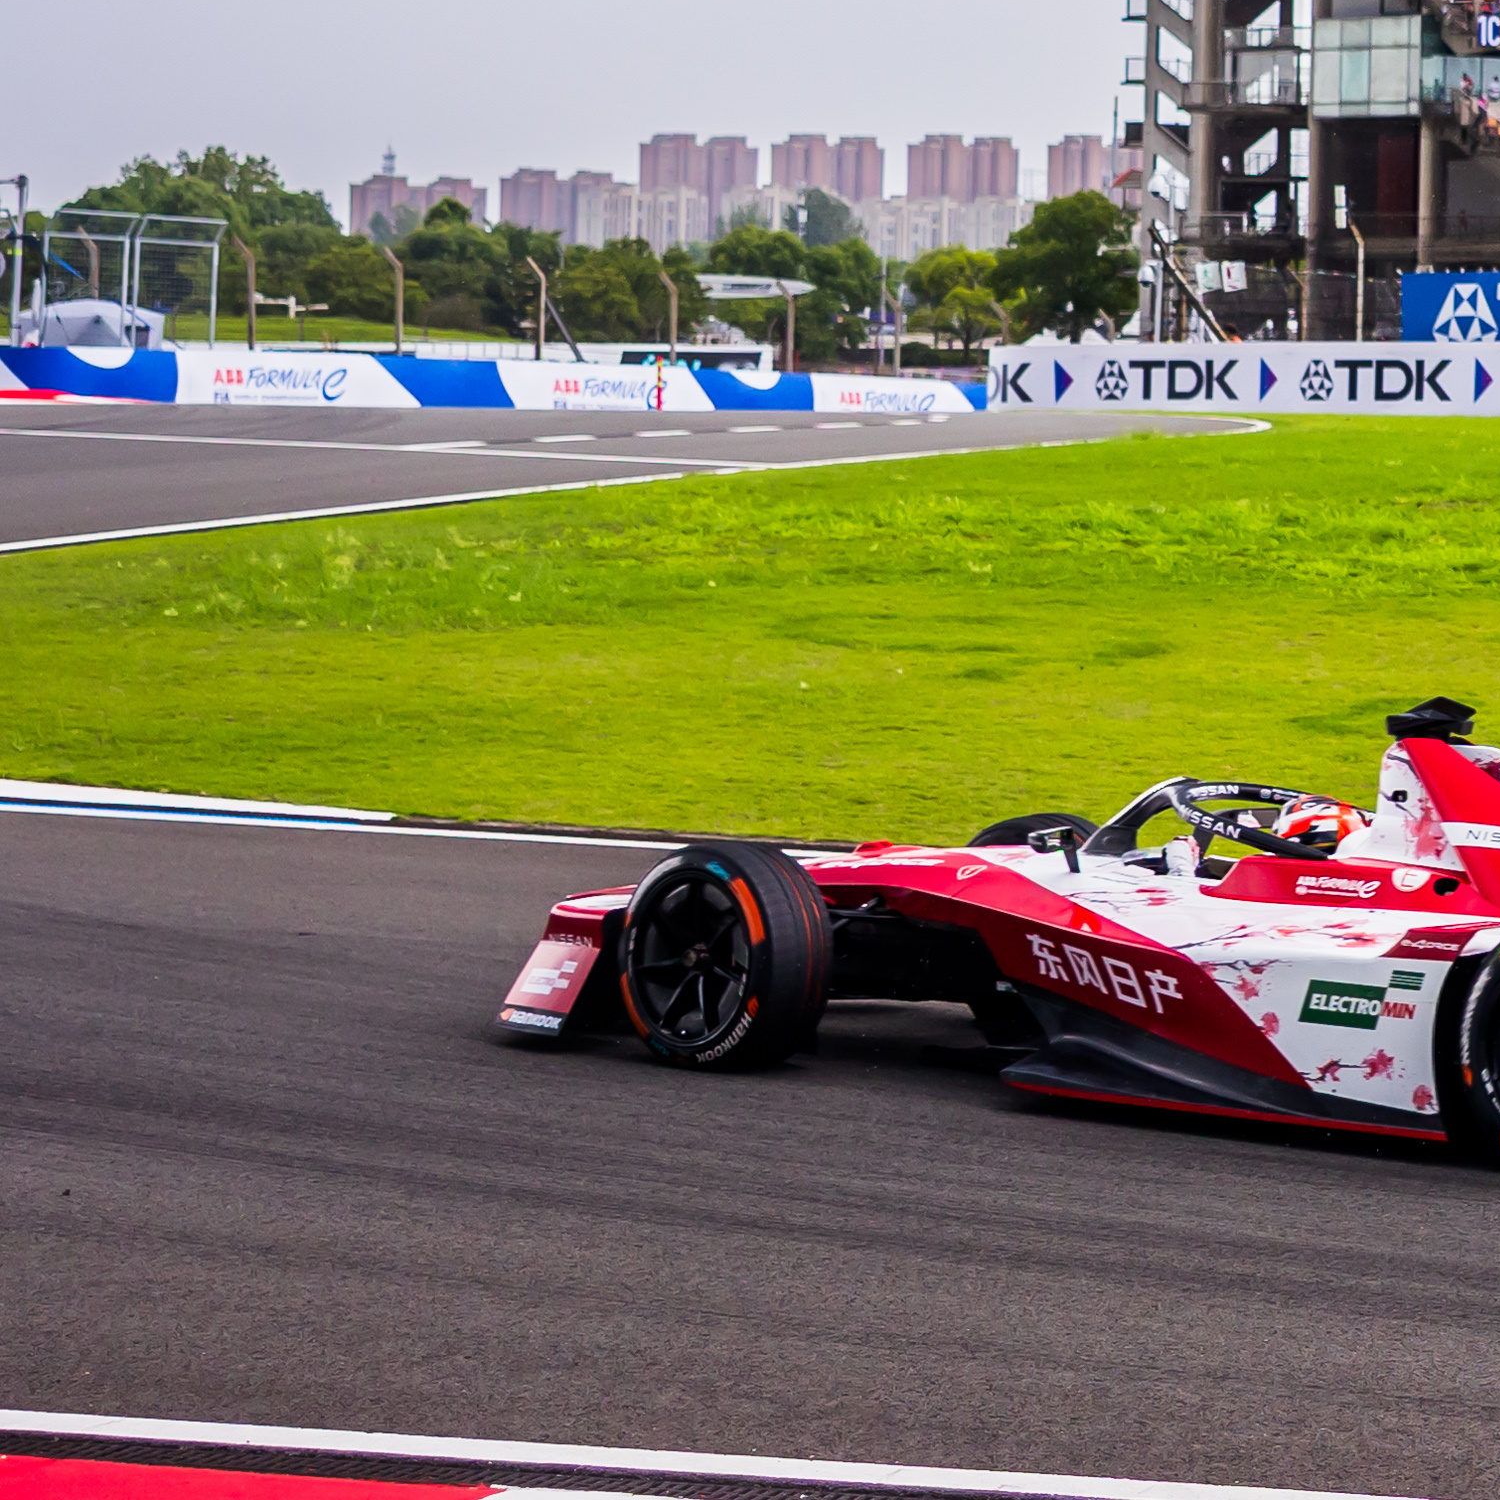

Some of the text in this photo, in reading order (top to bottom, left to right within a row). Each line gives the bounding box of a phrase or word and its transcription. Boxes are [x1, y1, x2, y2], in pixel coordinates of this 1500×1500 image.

[246, 366, 323, 389] FORMULA
[1130, 359, 1239, 401] TDK
[1334, 359, 1452, 402] TDK
[1178, 803, 1242, 840] NISSAN
[1025, 933, 1184, 1014] 东风日产
